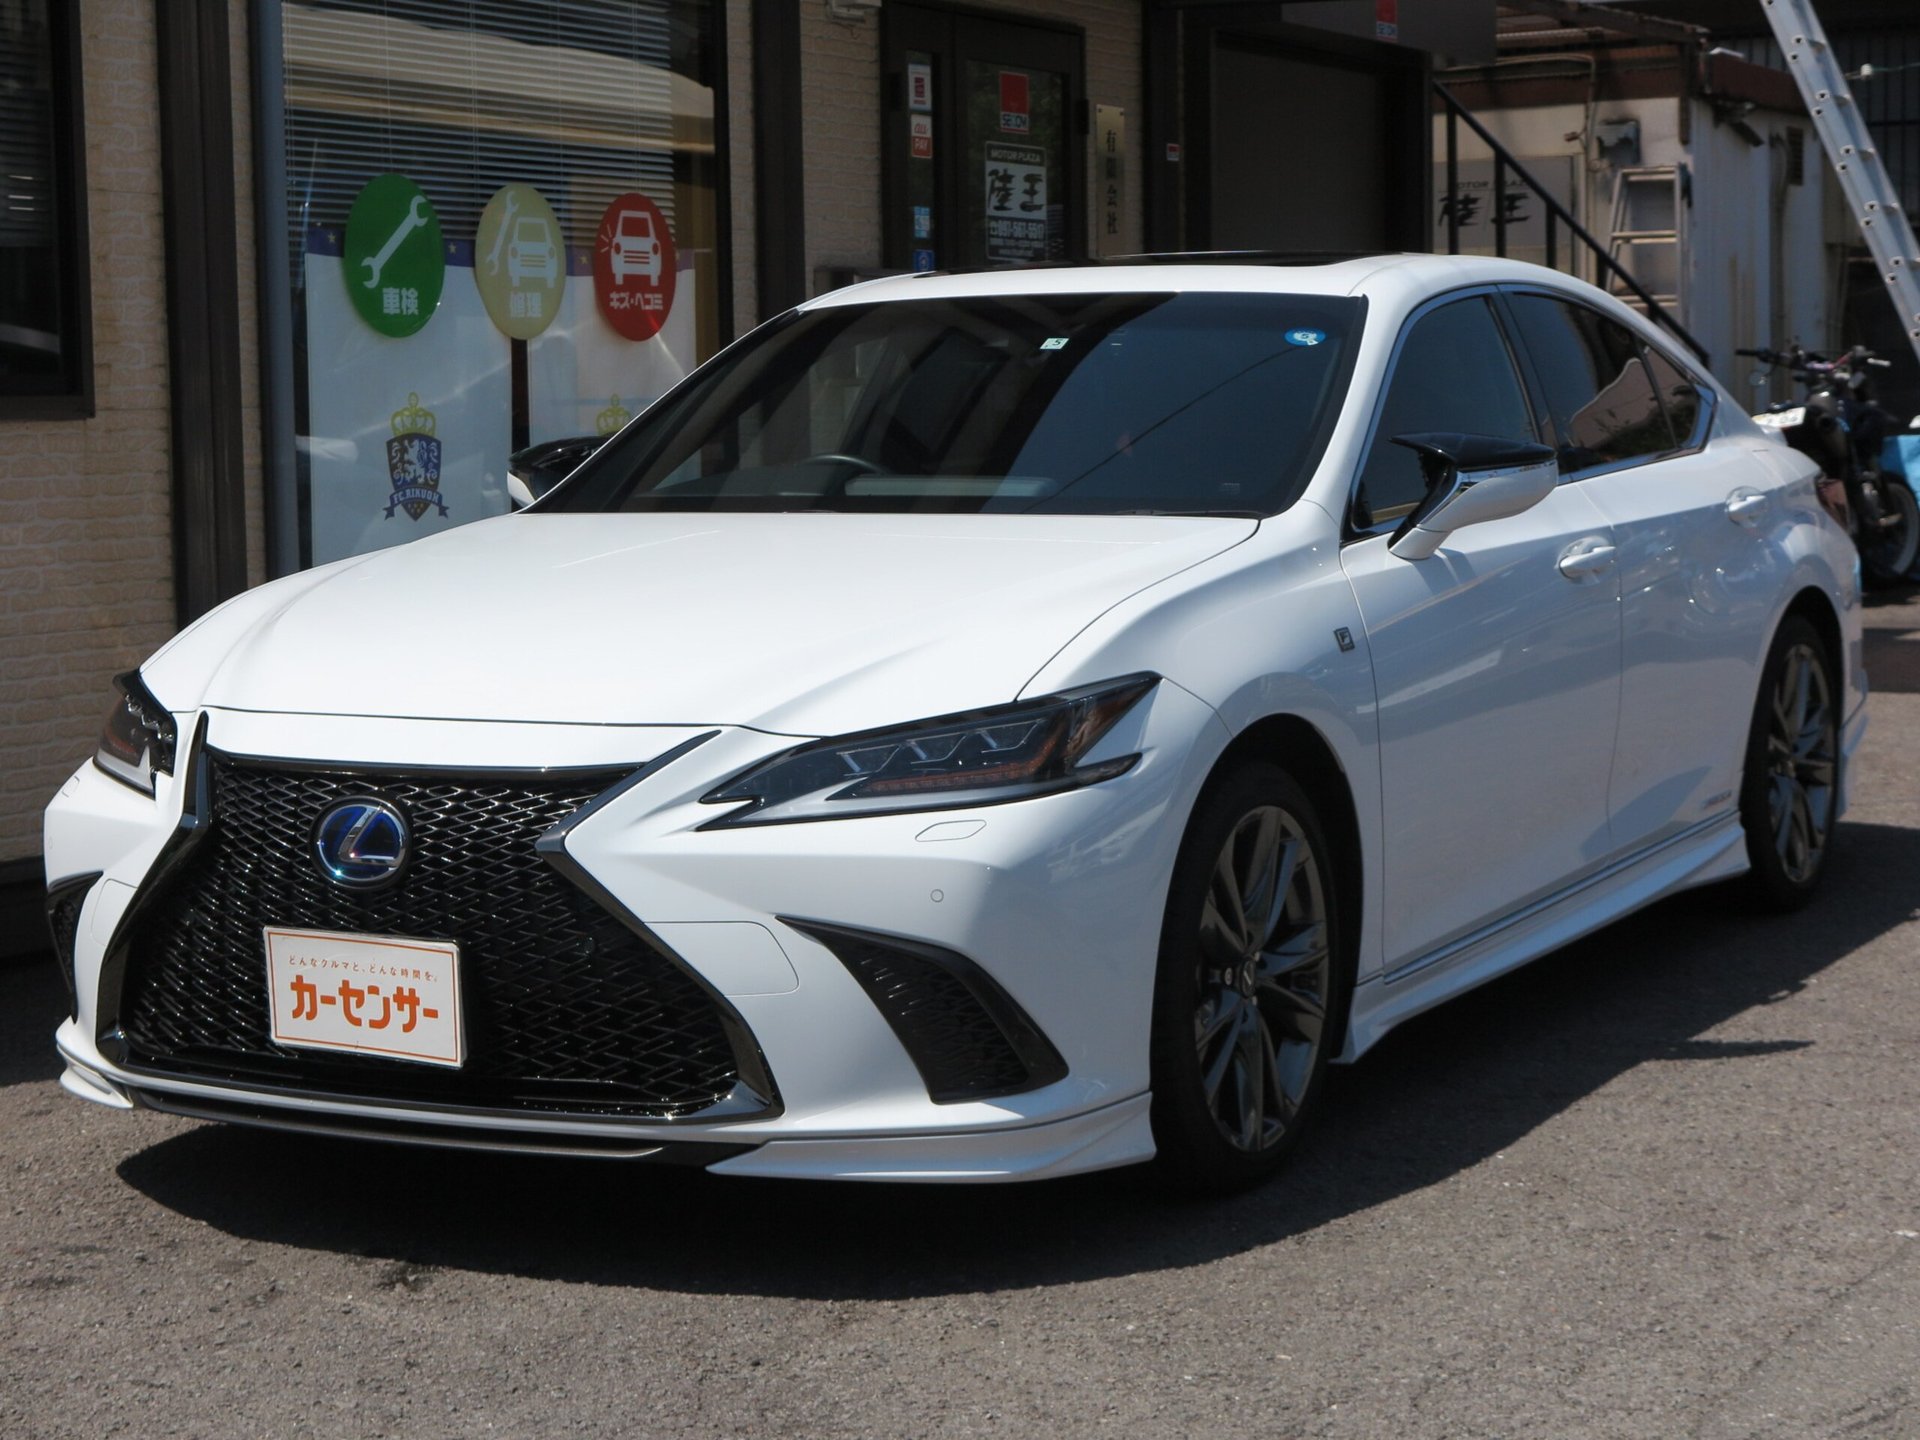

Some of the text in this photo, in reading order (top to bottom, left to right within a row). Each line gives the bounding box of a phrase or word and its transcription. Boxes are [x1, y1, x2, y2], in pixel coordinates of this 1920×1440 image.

[382, 287, 419, 315] 車検
[510, 292, 542, 319] 修理
[609, 291, 663, 310] キズ・ヘコミ
[289, 955, 438, 982] どんなクルマと、どんな時間を。
[290, 974, 439, 1033] カーセンサー
